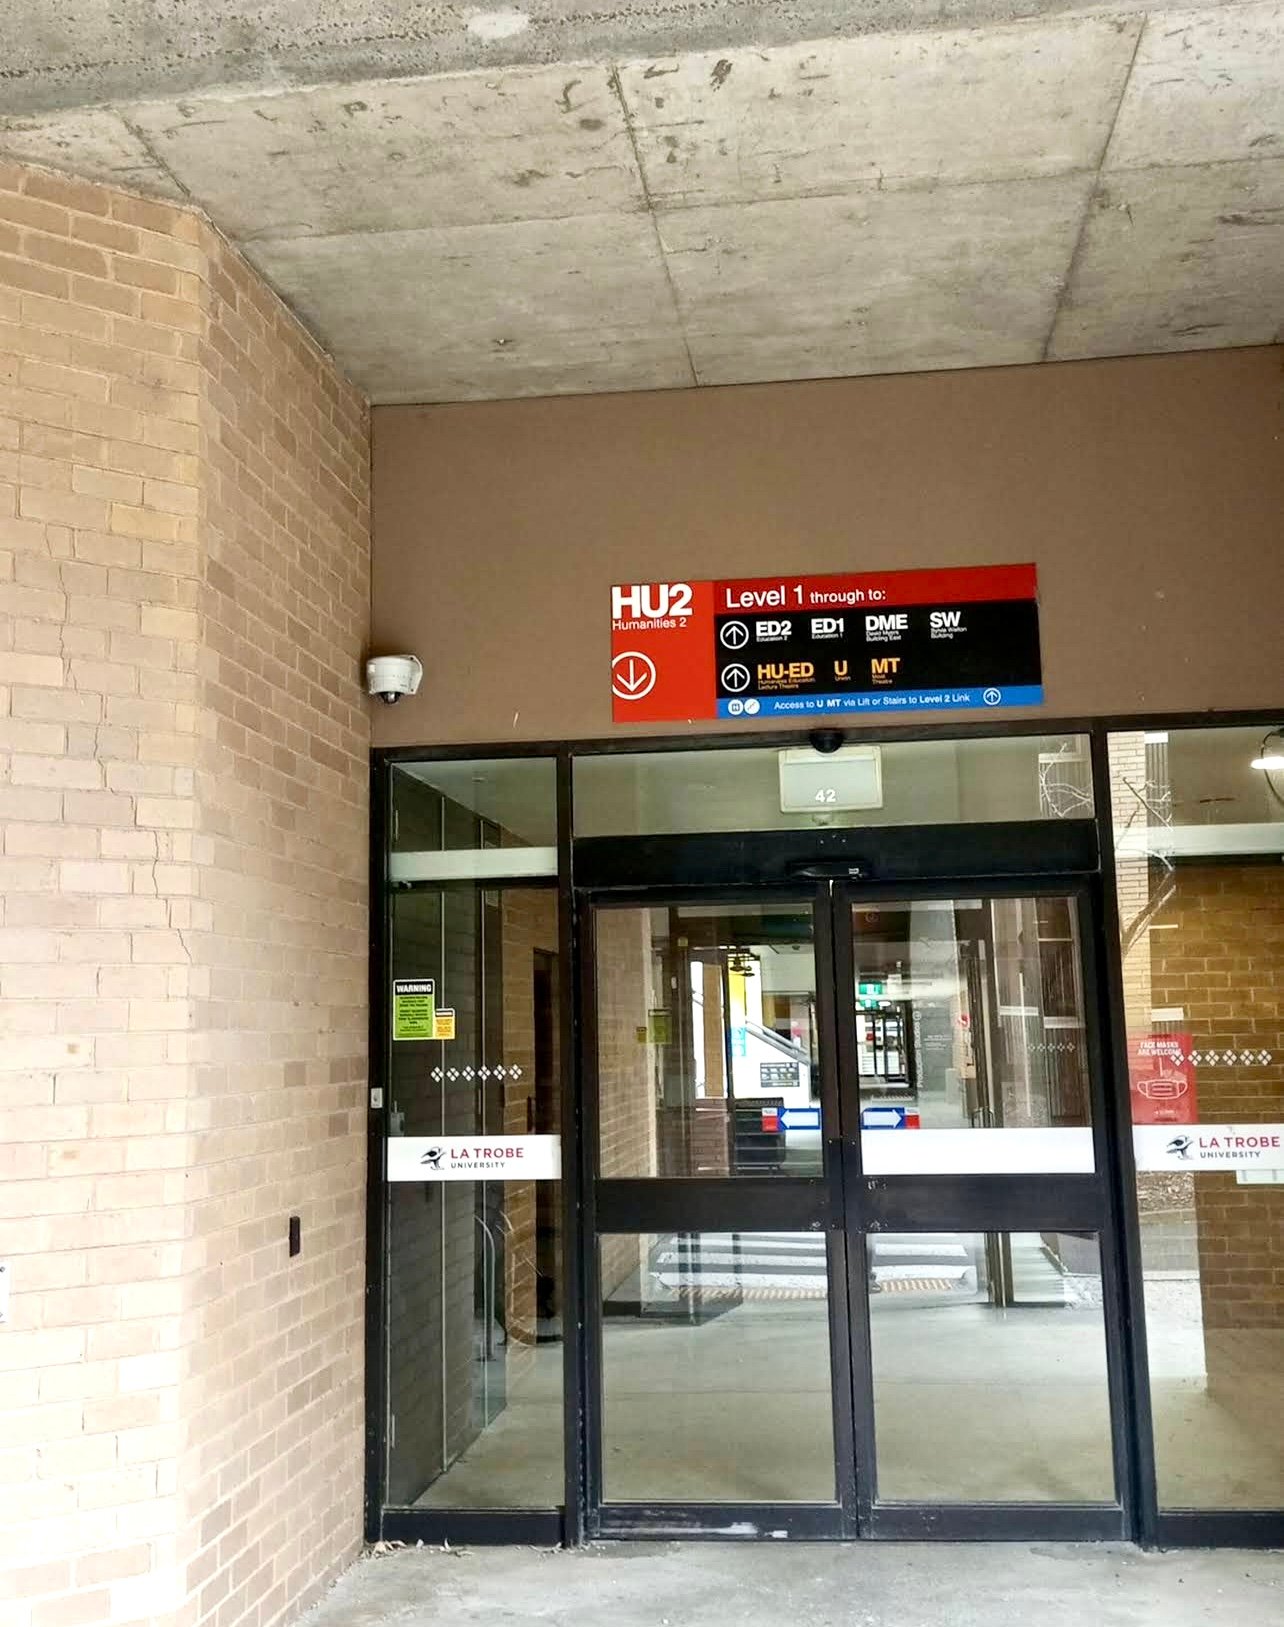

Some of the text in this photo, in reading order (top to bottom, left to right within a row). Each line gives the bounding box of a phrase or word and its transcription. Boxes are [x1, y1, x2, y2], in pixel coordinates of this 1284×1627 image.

[612, 583, 692, 619] HU2
[726, 584, 886, 608] Level 1 through to:
[612, 617, 687, 631] Humanities 2
[811, 617, 844, 634] ED1
[865, 613, 908, 631] DME
[929, 611, 961, 628] SW
[756, 620, 792, 636] ED2
[757, 661, 814, 679] HU-ED
[833, 660, 848, 676] U
[871, 657, 900, 674] MT
[774, 701, 804, 710] Access
[806, 701, 815, 709] to
[827, 699, 841, 708] MT
[857, 698, 870, 706] Lift
[883, 696, 907, 705] Stairs
[909, 696, 917, 704] to
[919, 694, 943, 704] Level
[944, 694, 950, 702] 2
[952, 693, 970, 703] Link
[815, 789, 836, 803] 42
[396, 984, 432, 993] WARNING
[1137, 1048, 1150, 1056] ARE
[1140, 1041, 1155, 1049] FACE
[1199, 1136, 1281, 1148] LA TROBE
[450, 1147, 524, 1159] LA TROBE
[1200, 1151, 1261, 1159] UNIVERSITY
[450, 1161, 505, 1169] UNIVERSITY
